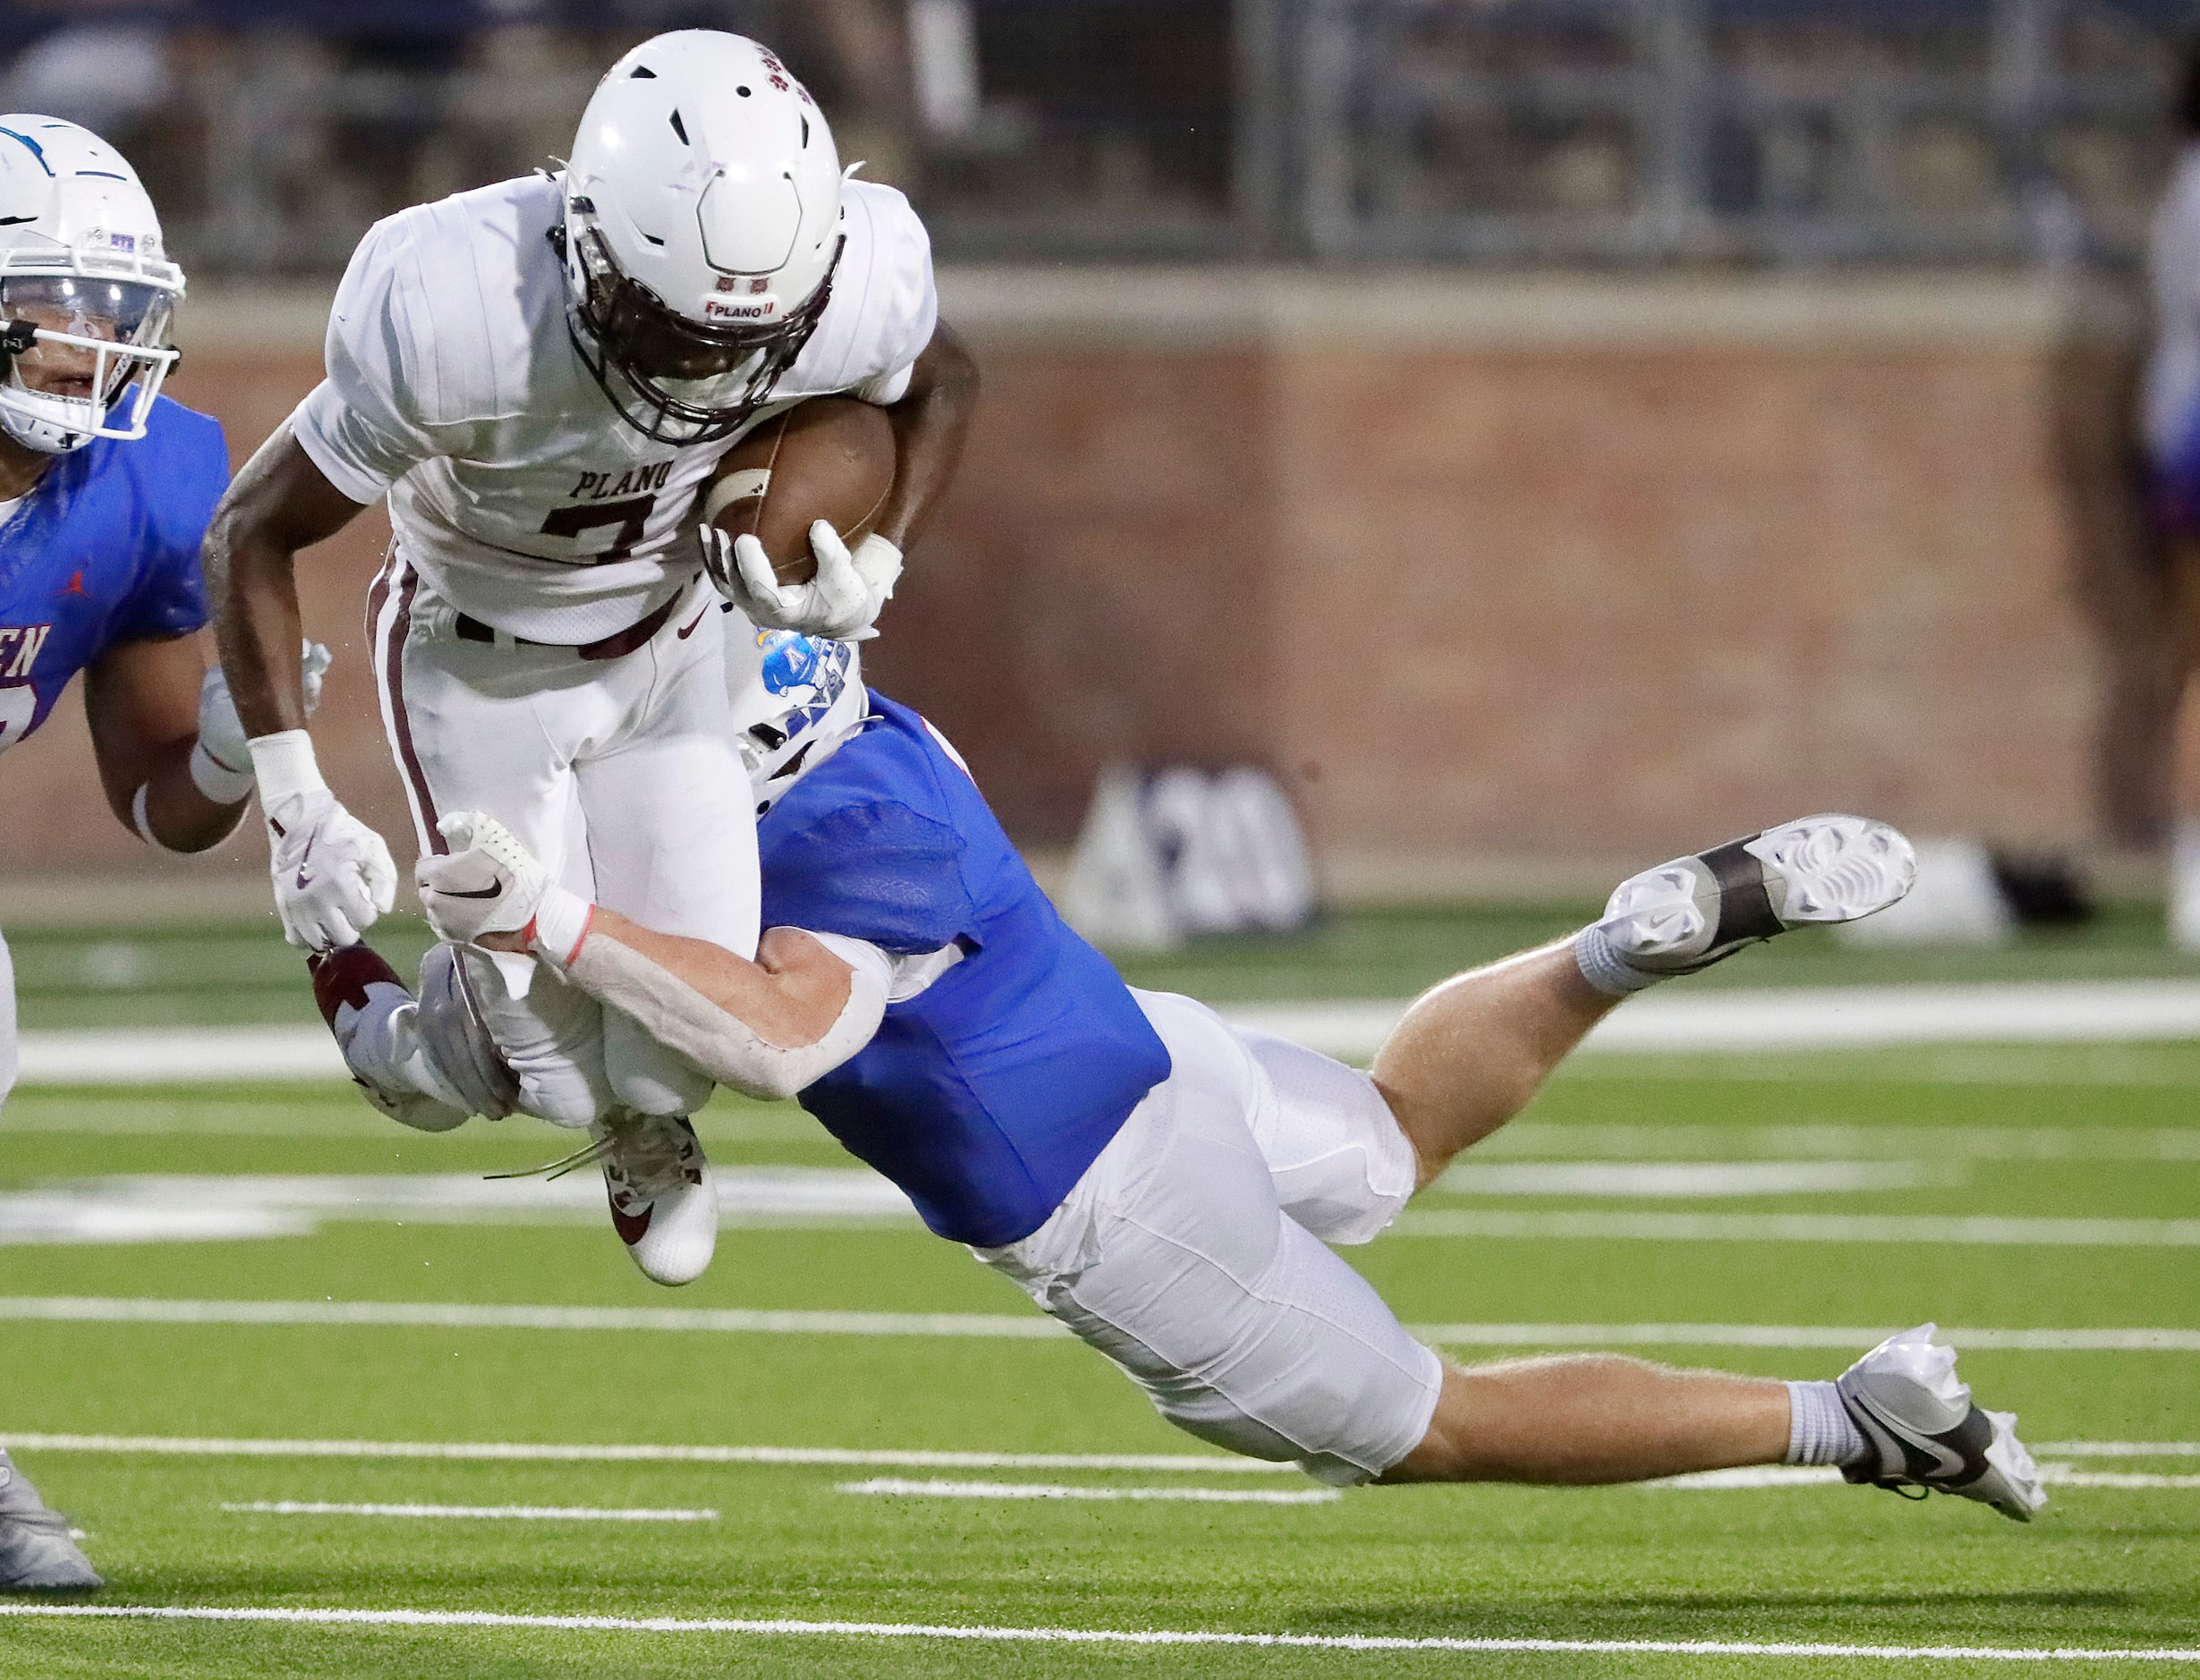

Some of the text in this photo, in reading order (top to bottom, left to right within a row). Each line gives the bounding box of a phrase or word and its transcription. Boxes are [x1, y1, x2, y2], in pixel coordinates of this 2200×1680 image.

[715, 305, 761, 318] PLANO
[569, 459, 675, 499] PLANO
[539, 492, 659, 565] 7
[782, 643, 807, 674] A
